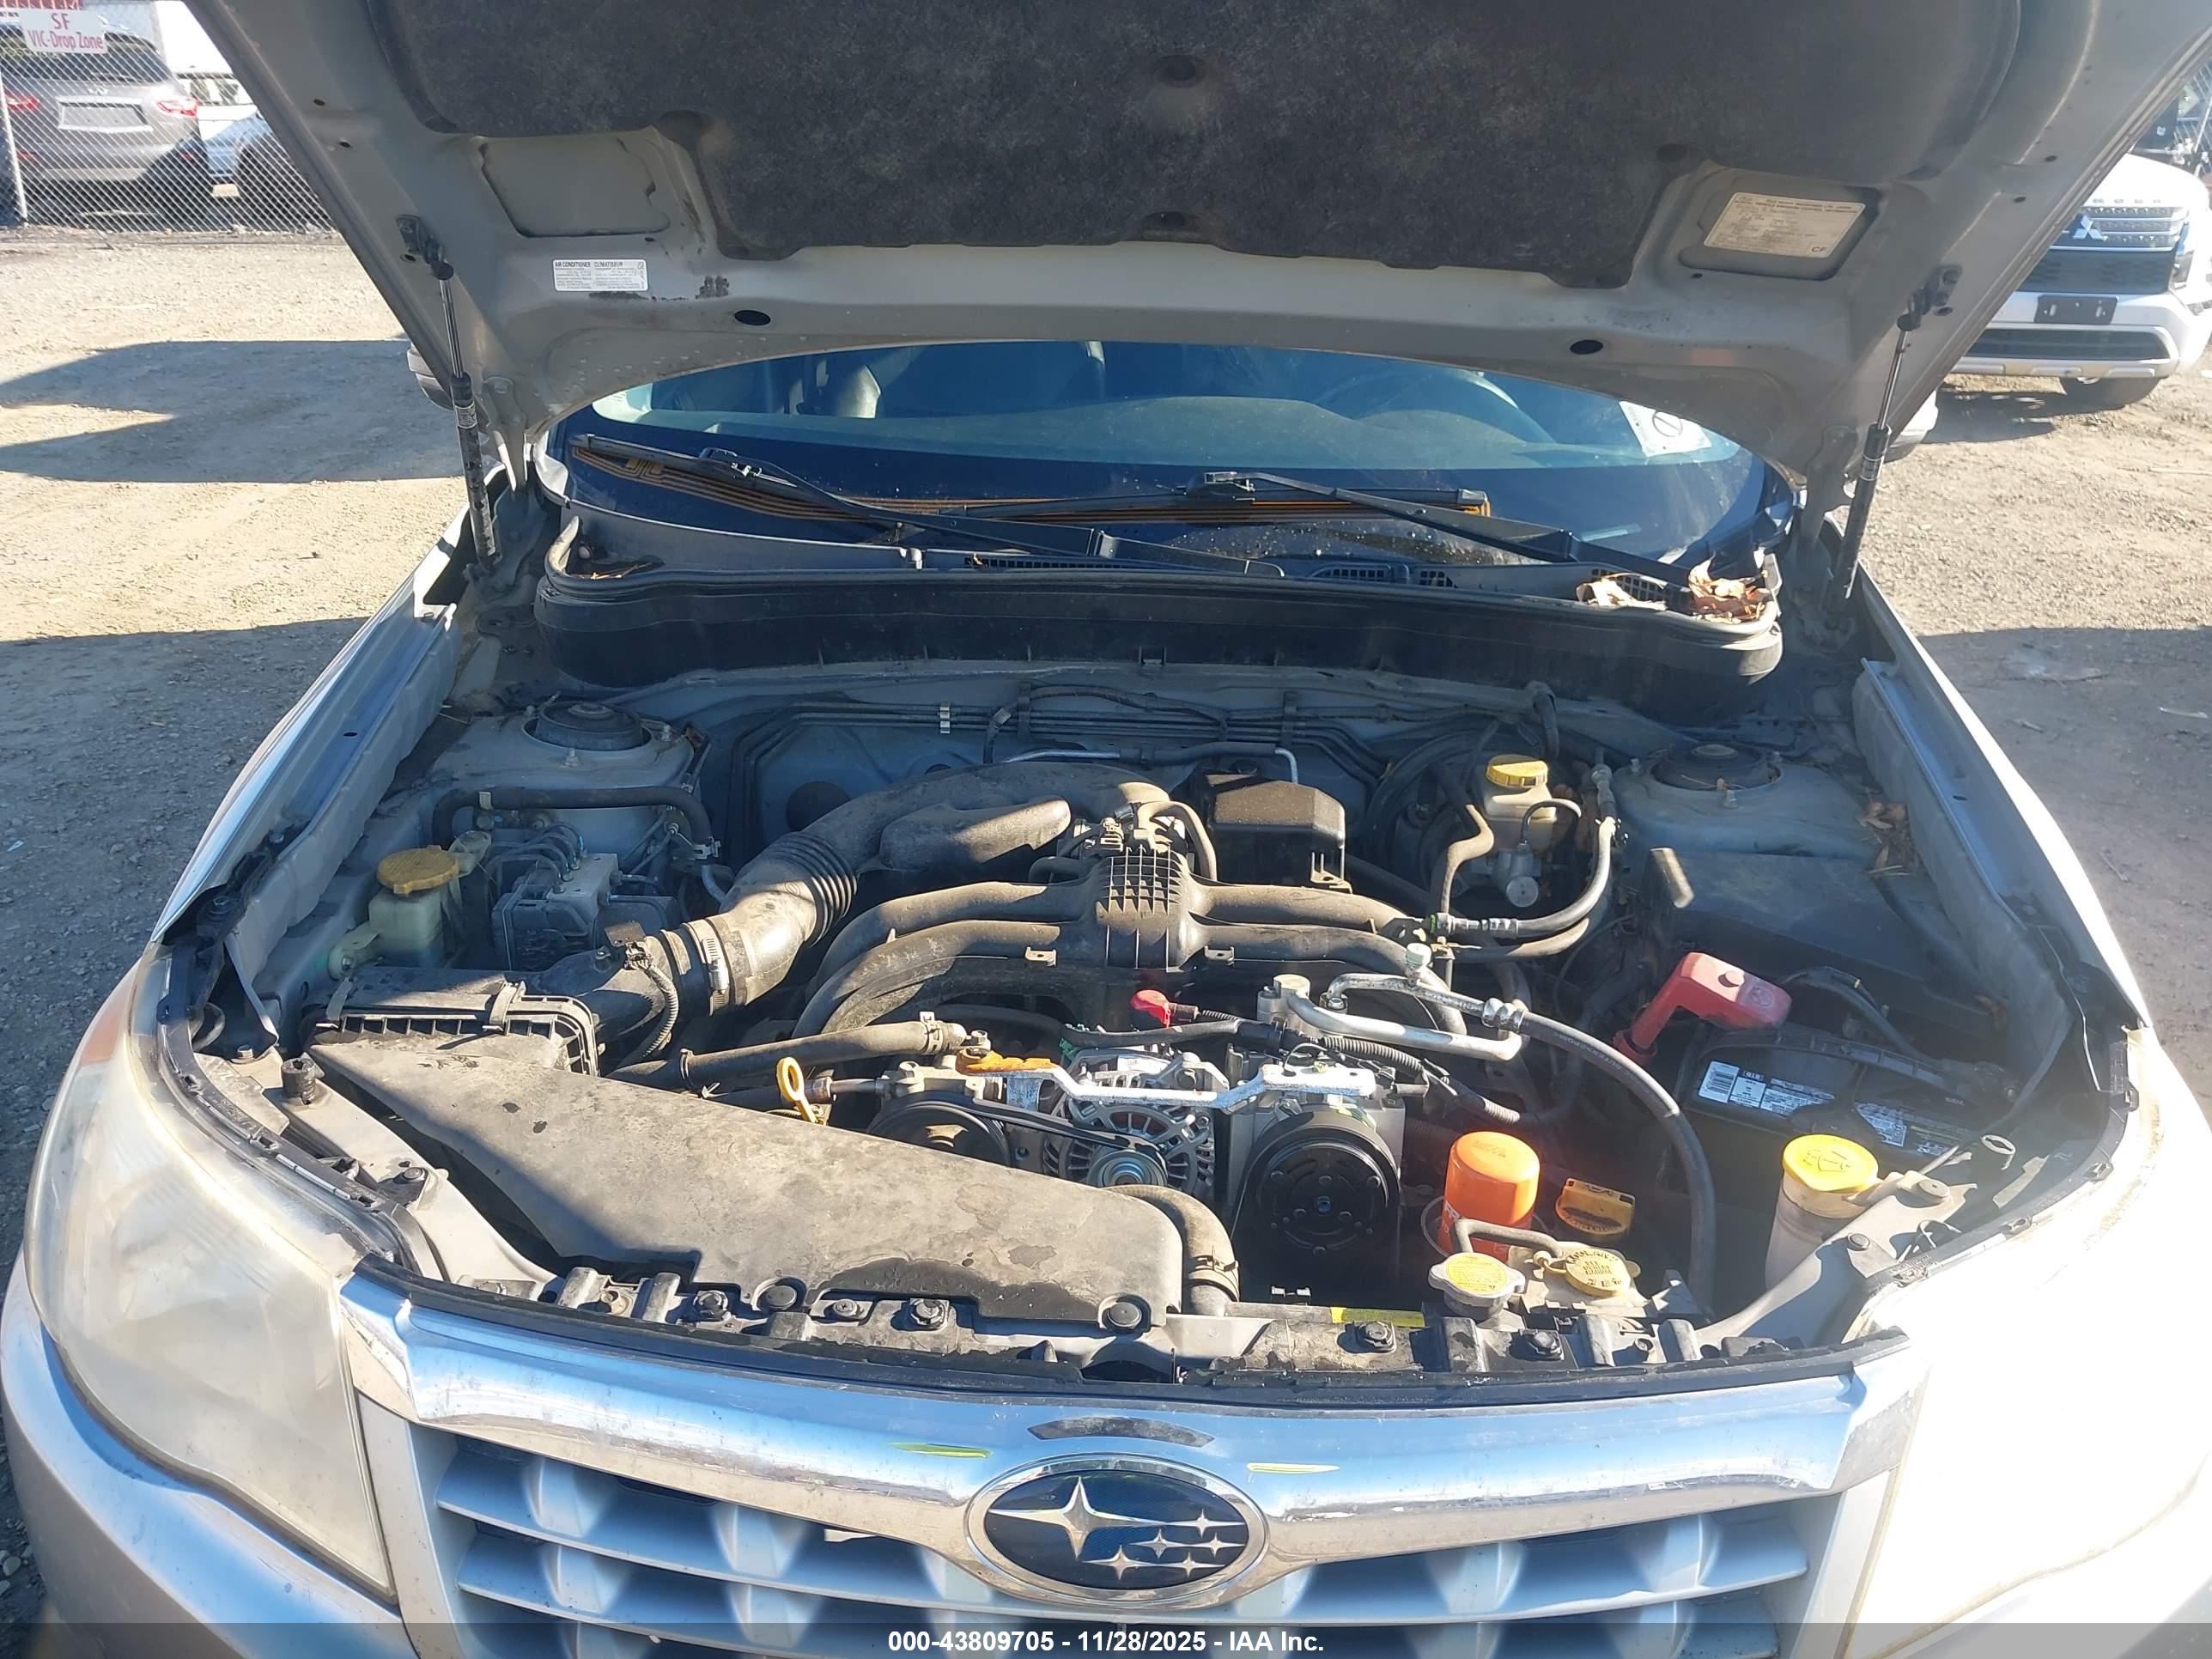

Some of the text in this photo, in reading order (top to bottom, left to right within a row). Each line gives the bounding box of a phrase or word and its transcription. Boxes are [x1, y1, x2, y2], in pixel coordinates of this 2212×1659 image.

[51, 12, 70, 30] SF
[27, 29, 104, 51] VIC-Drop Zone
